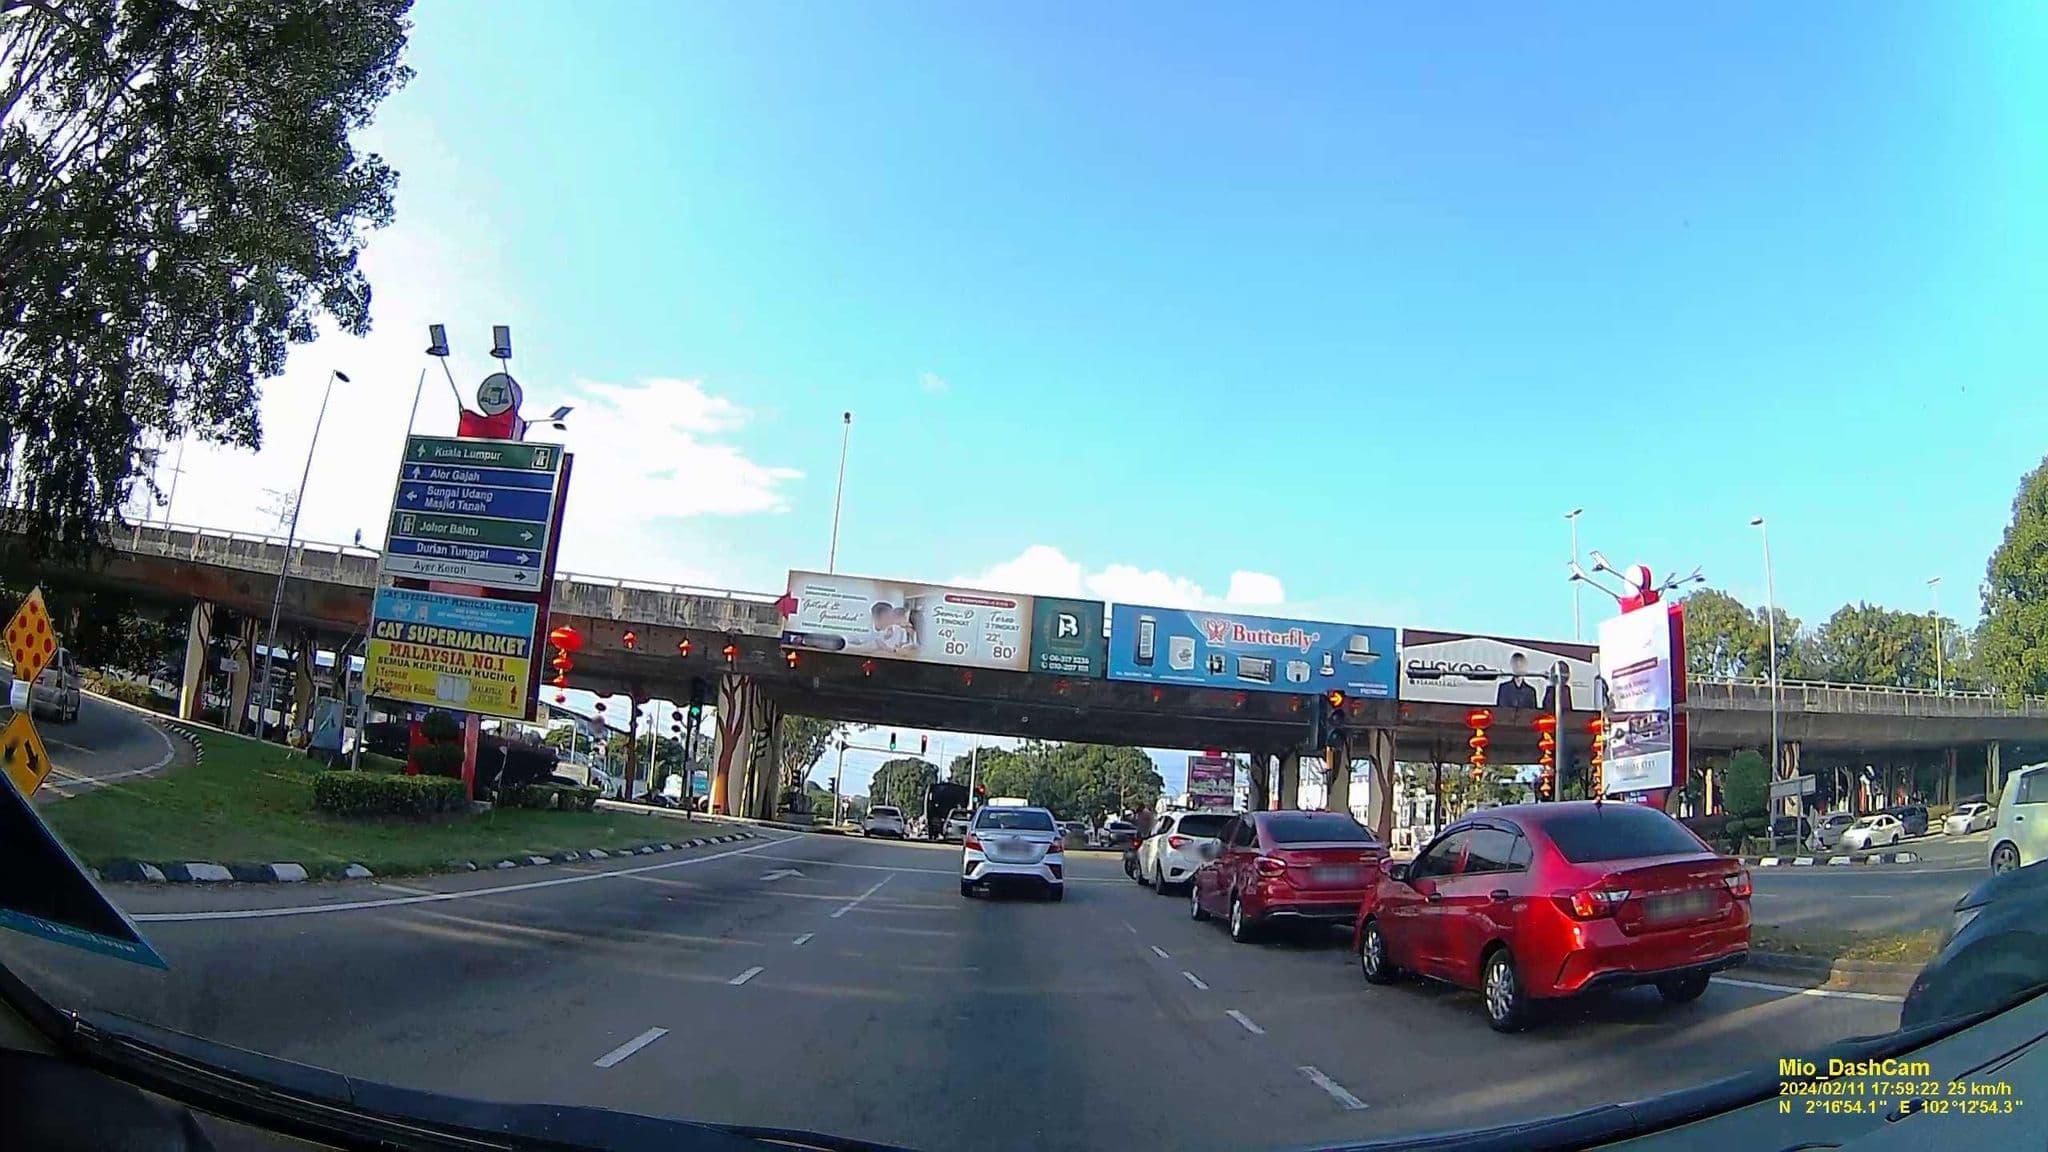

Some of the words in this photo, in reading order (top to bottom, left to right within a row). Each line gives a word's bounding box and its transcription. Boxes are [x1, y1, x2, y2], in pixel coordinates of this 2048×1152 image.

[434, 446, 461, 458] Kuala
[464, 448, 502, 462] Lumpur
[430, 469, 450, 480] Alor
[452, 470, 480, 483] Gajah
[427, 486, 460, 500] Sungai
[462, 488, 493, 502] Udang
[424, 497, 455, 511] Masjid
[457, 499, 486, 512] Tanah
[420, 521, 448, 533] Johor
[450, 523, 479, 536] Bahru
[416, 543, 448, 555] Durian
[450, 545, 489, 560] Tunggal
[413, 560, 437, 573] Ayer
[376, 622, 404, 639] CAT
[407, 626, 526, 656] SUPERMARKET
[1232, 623, 1313, 653] Butterfly
[945, 641, 968, 655] 80'
[993, 646, 1016, 659] 80'
[388, 643, 466, 667] MALAYSIA
[472, 655, 505, 672] NO.1
[378, 657, 410, 669] SEMUA
[413, 661, 472, 677] KEPERLUAN
[474, 670, 516, 683] KUCING
